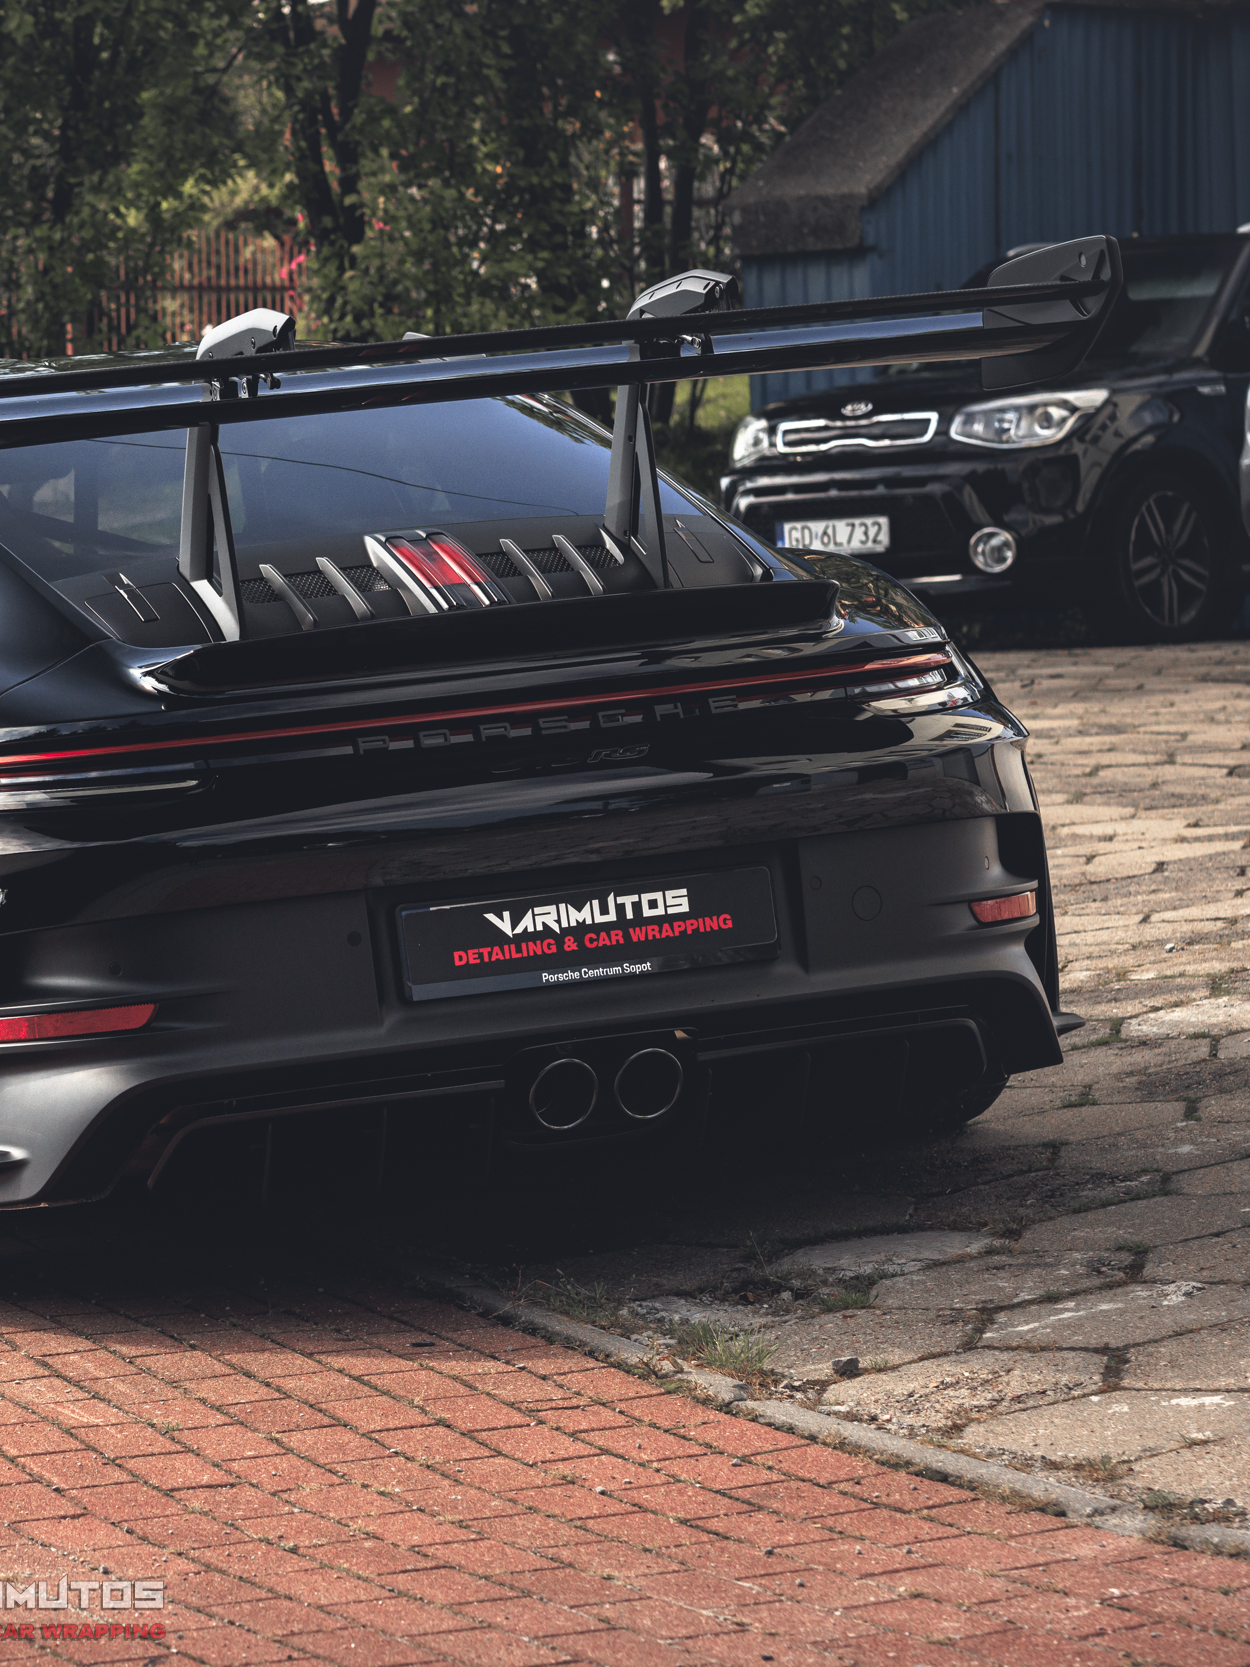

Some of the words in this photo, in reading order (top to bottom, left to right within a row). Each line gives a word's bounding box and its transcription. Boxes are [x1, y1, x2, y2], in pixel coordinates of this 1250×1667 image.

[788, 524, 813, 548] GD
[819, 520, 883, 547] 6L732
[356, 695, 738, 755] PORSCHE
[483, 888, 690, 938] VARIMUTOS
[453, 938, 558, 967] DETAILING
[563, 935, 579, 952] &
[584, 929, 625, 948] CAR
[628, 913, 734, 942] WRAPPING
[542, 969, 580, 983] Porsche
[581, 965, 622, 979] Centrum
[623, 960, 652, 976] Sopot
